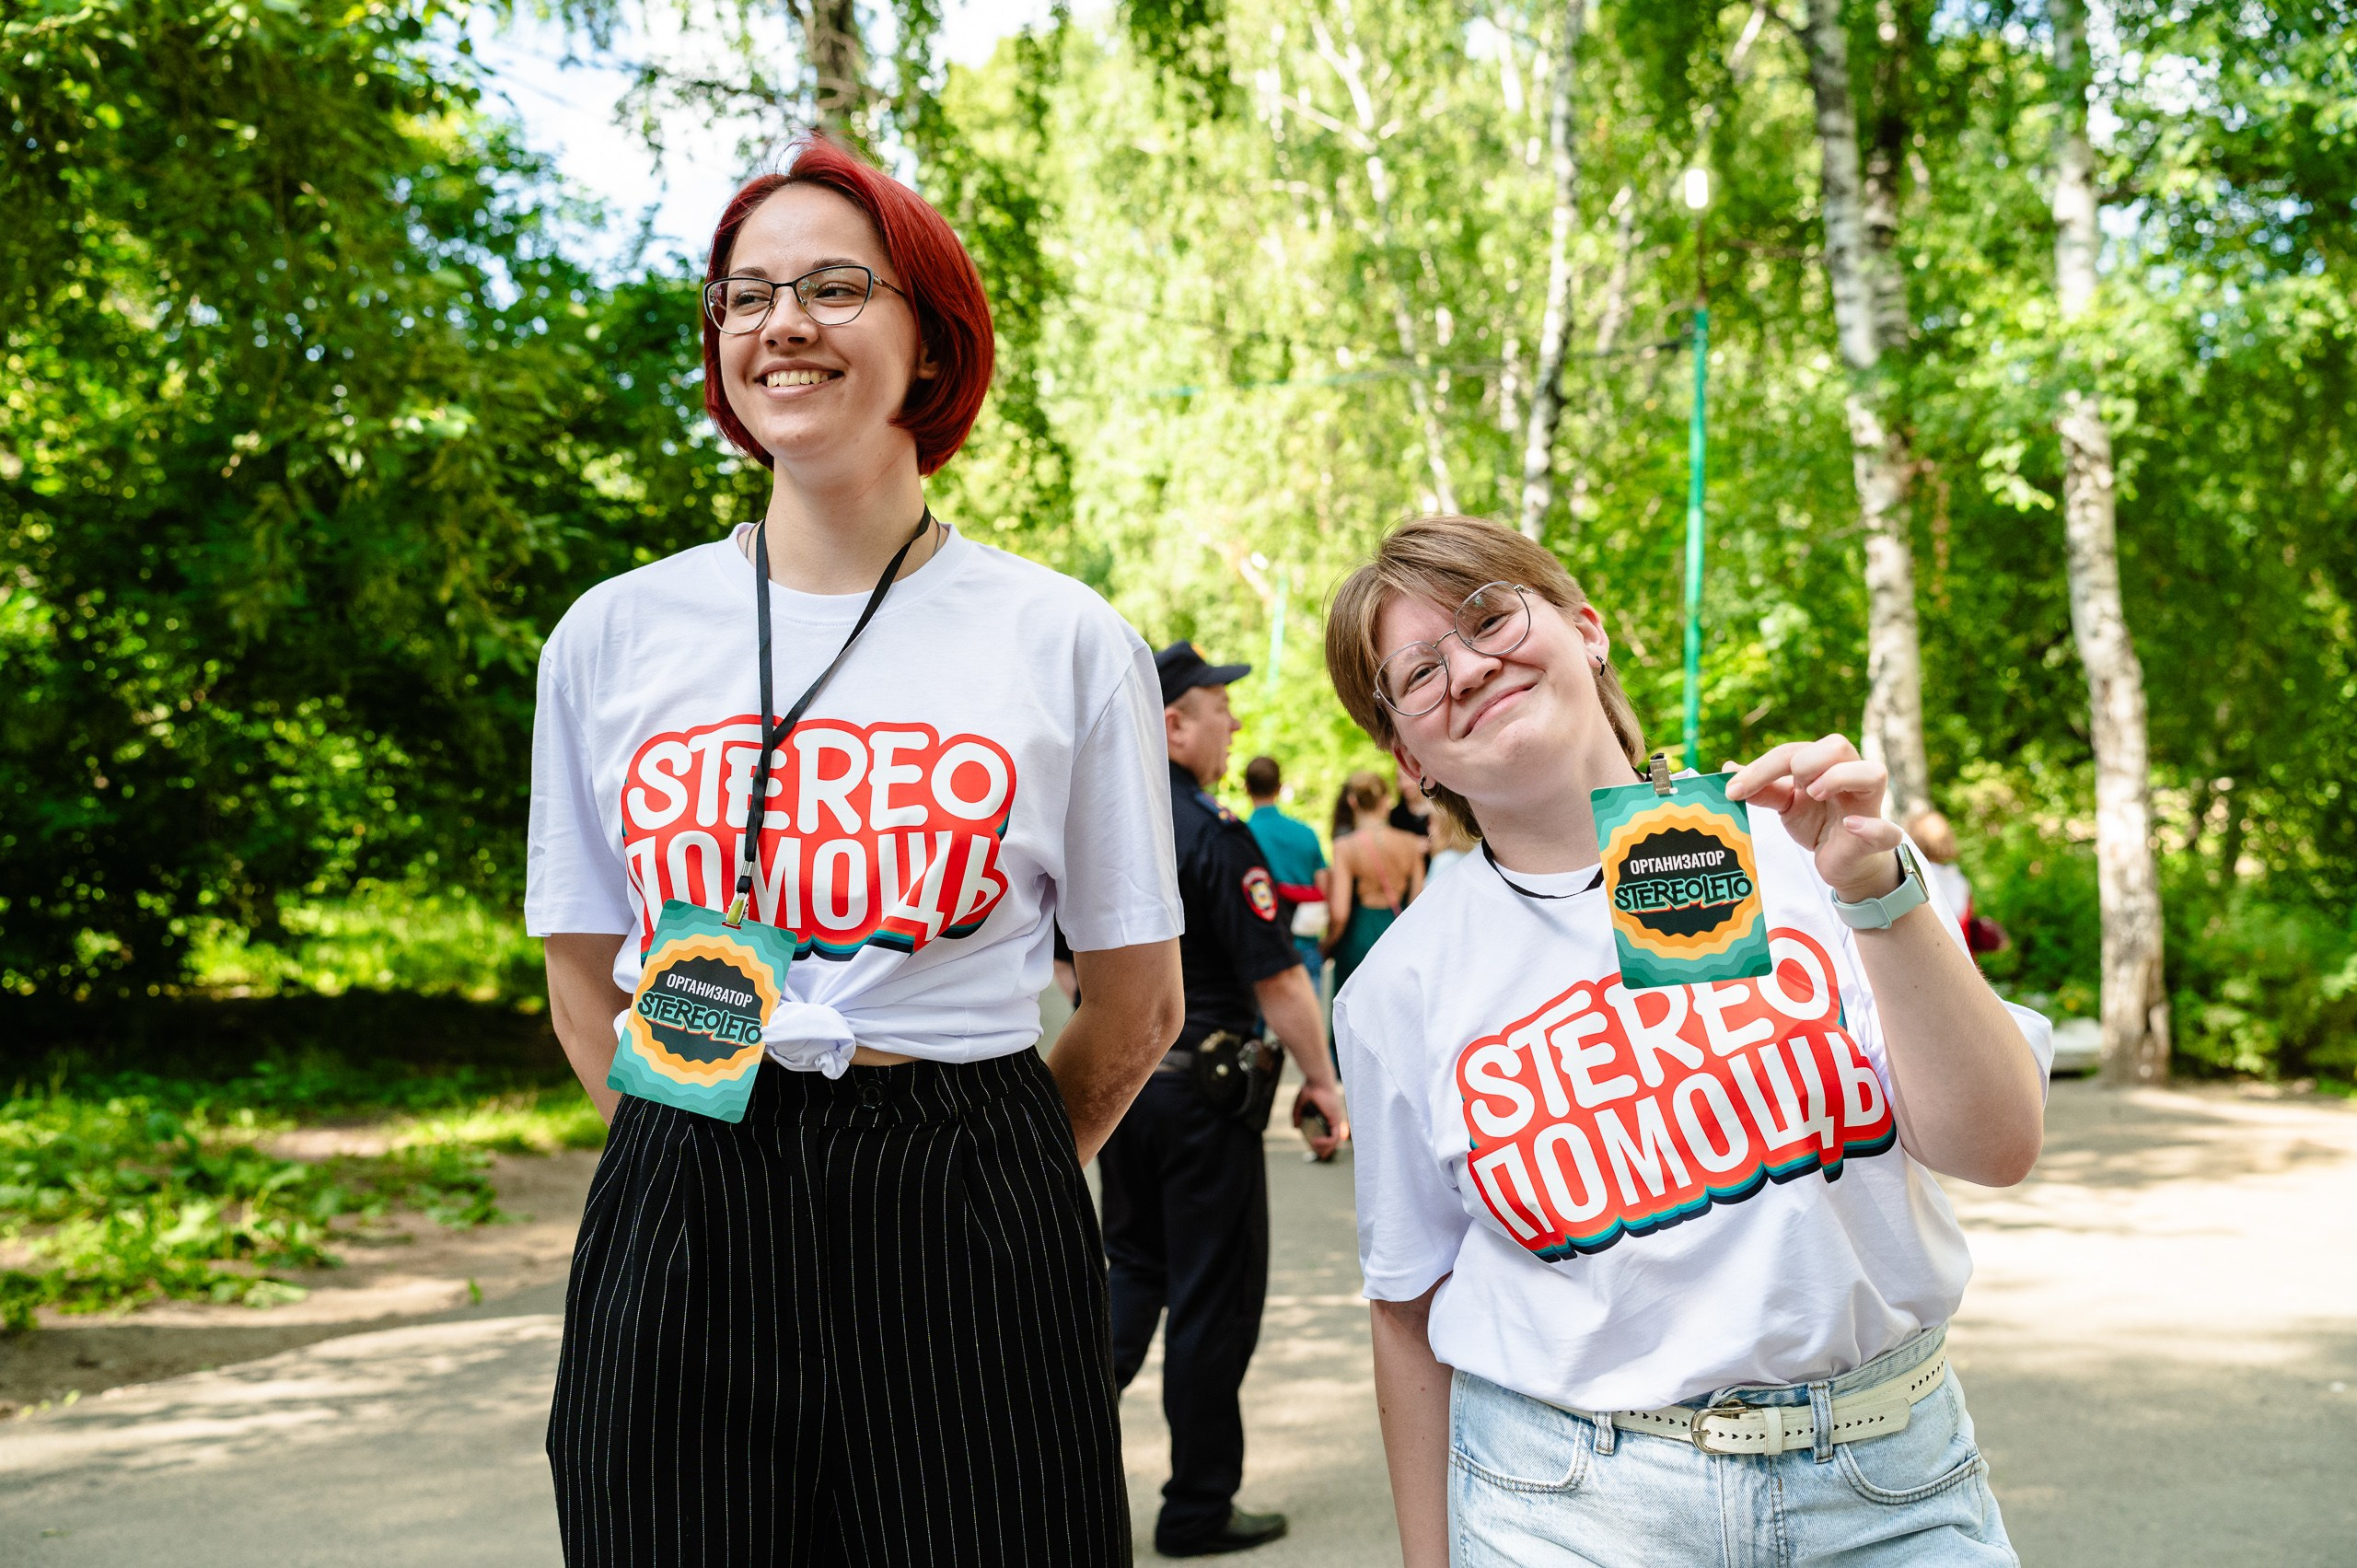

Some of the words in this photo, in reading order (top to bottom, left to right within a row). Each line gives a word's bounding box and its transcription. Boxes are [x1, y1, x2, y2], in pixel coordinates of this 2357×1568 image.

[627, 724, 1009, 834] STEREO
[625, 830, 1002, 942] ПОМОЩЬ
[1630, 850, 1725, 875] ОРГАНИЗАТОР
[667, 973, 753, 1008] ОРГАНИЗАТОР
[1464, 936, 1830, 1138] STEREO
[1472, 1031, 1885, 1241] ПОМОЩЬ
